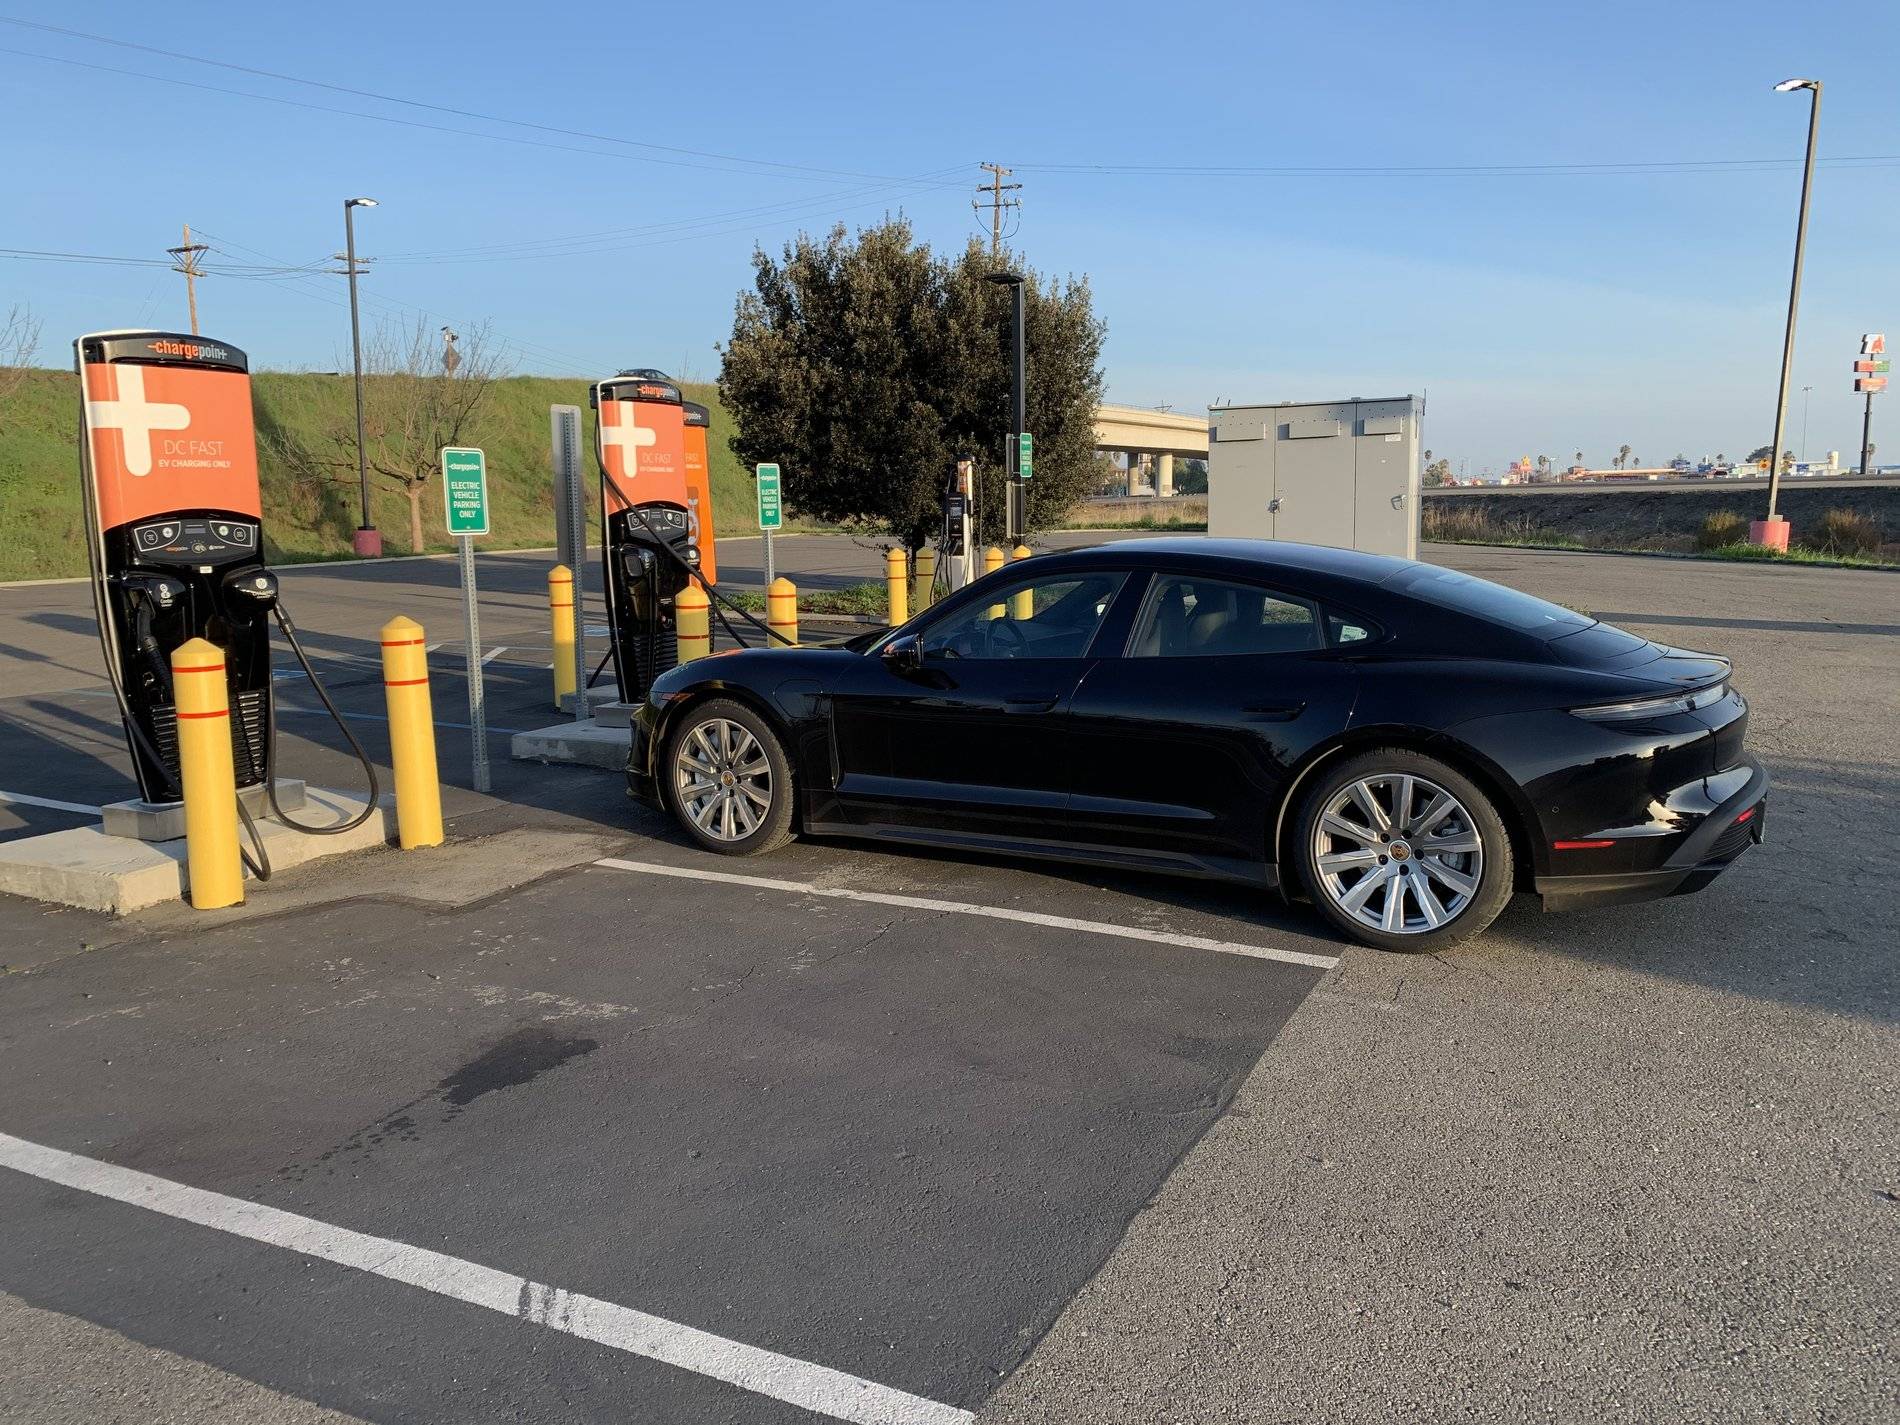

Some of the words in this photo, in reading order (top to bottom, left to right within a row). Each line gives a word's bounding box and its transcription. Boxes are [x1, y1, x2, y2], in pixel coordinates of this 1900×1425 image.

[163, 439, 186, 455] DC
[189, 440, 224, 456] FAST
[158, 459, 170, 468] EV
[170, 459, 211, 468] CHARGING
[212, 460, 231, 469] ONLY
[453, 491, 480, 499] VEHICLE
[453, 501, 481, 509] PARKING
